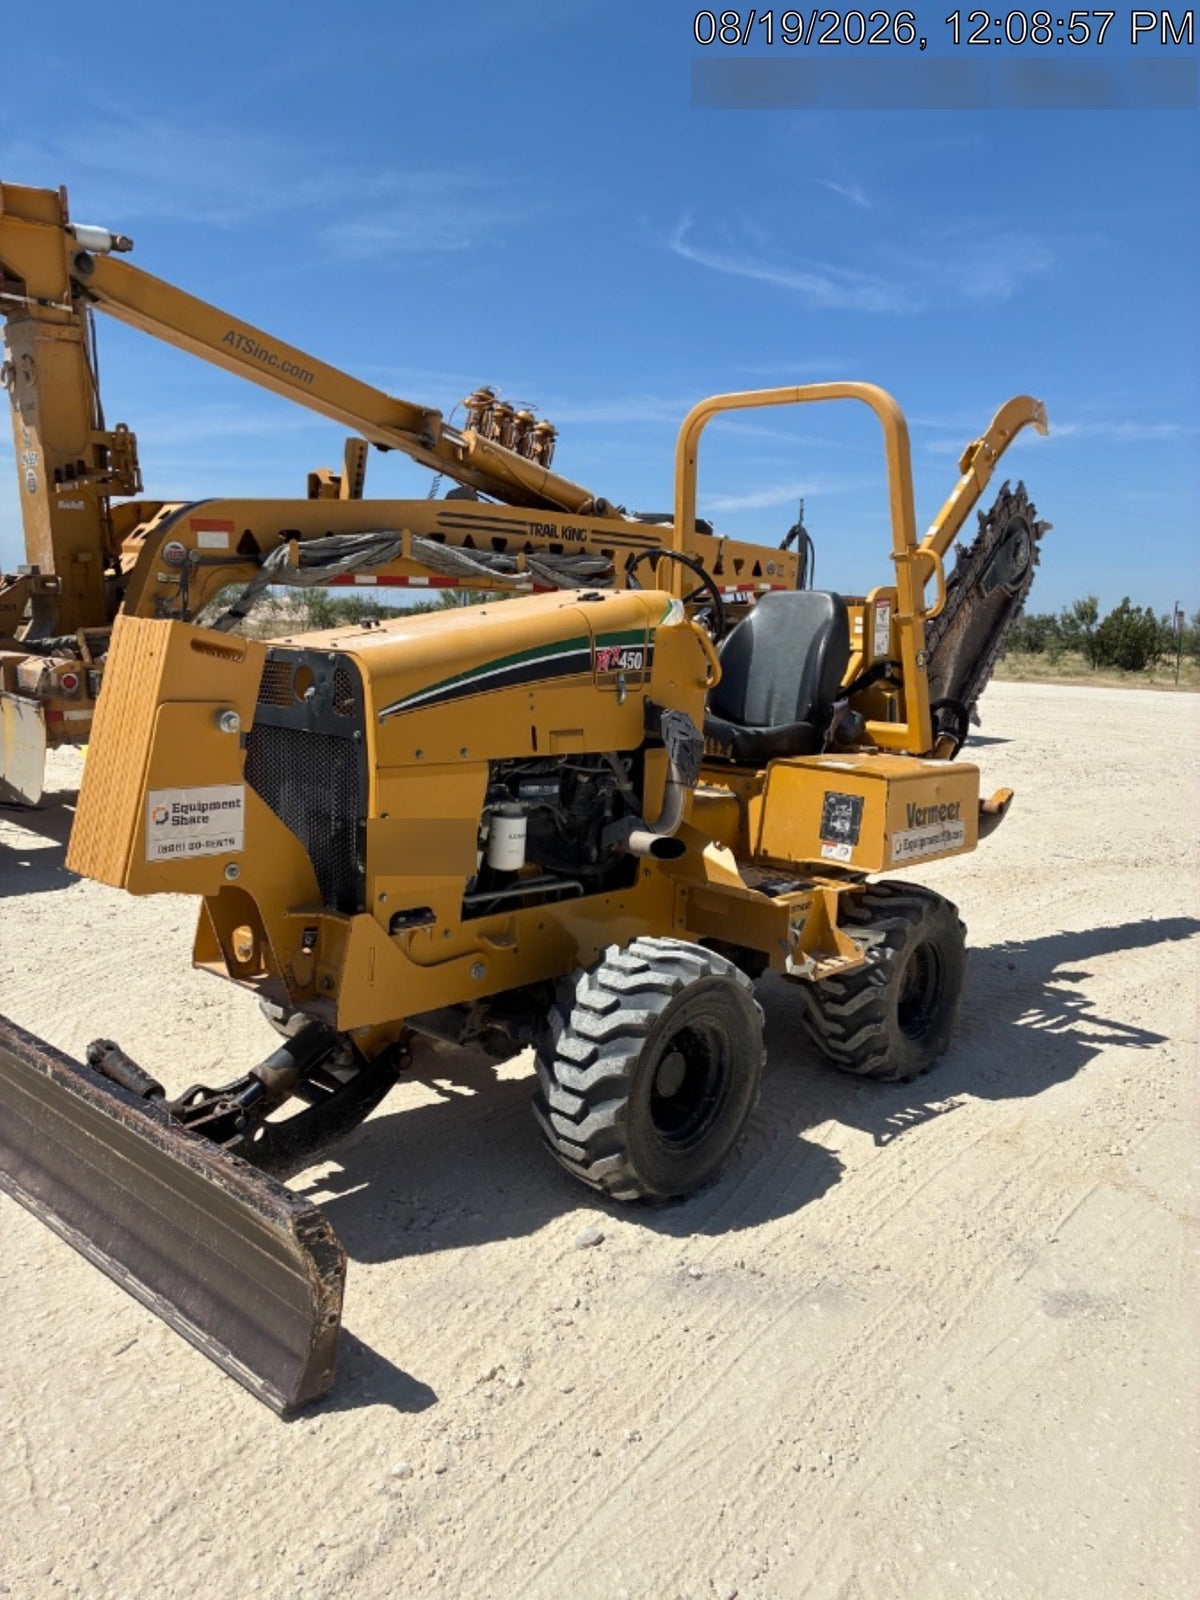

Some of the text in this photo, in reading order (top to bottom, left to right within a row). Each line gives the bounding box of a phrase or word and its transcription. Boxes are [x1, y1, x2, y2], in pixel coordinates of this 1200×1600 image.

[222, 329, 315, 385] ATSinc.com
[171, 798, 241, 815] Equipment
[906, 801, 961, 829] Vermeer
[171, 815, 209, 827] Share
